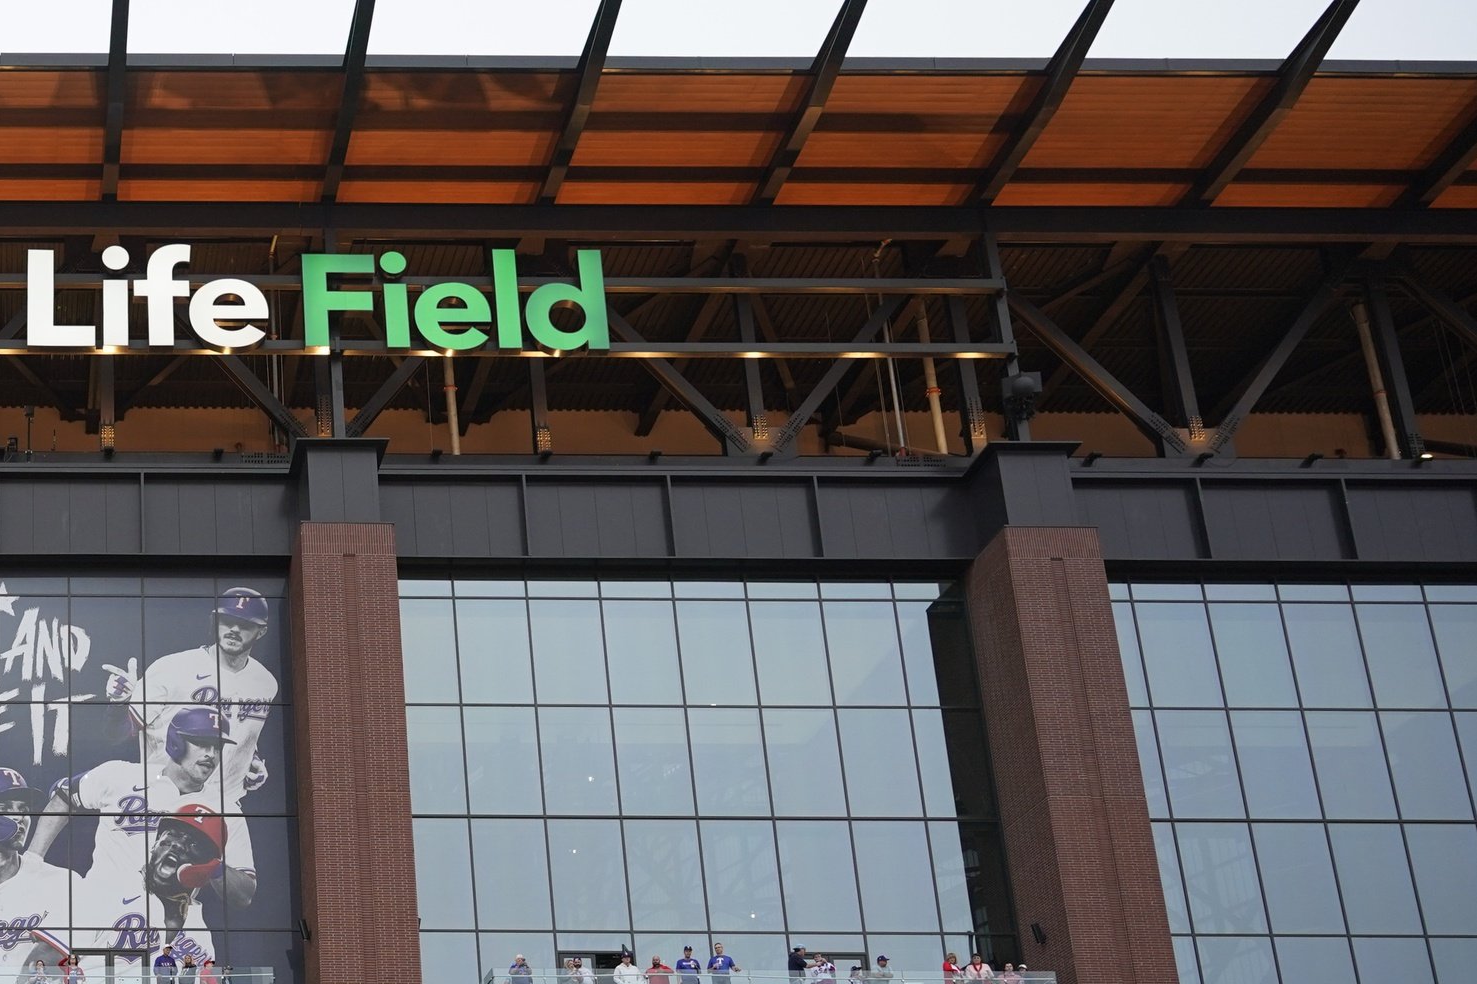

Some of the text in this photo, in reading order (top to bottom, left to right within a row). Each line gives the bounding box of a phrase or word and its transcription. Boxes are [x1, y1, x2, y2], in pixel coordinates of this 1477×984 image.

[27, 244, 270, 348] Life
[303, 248, 606, 352] Field
[32, 681, 98, 767] IT
